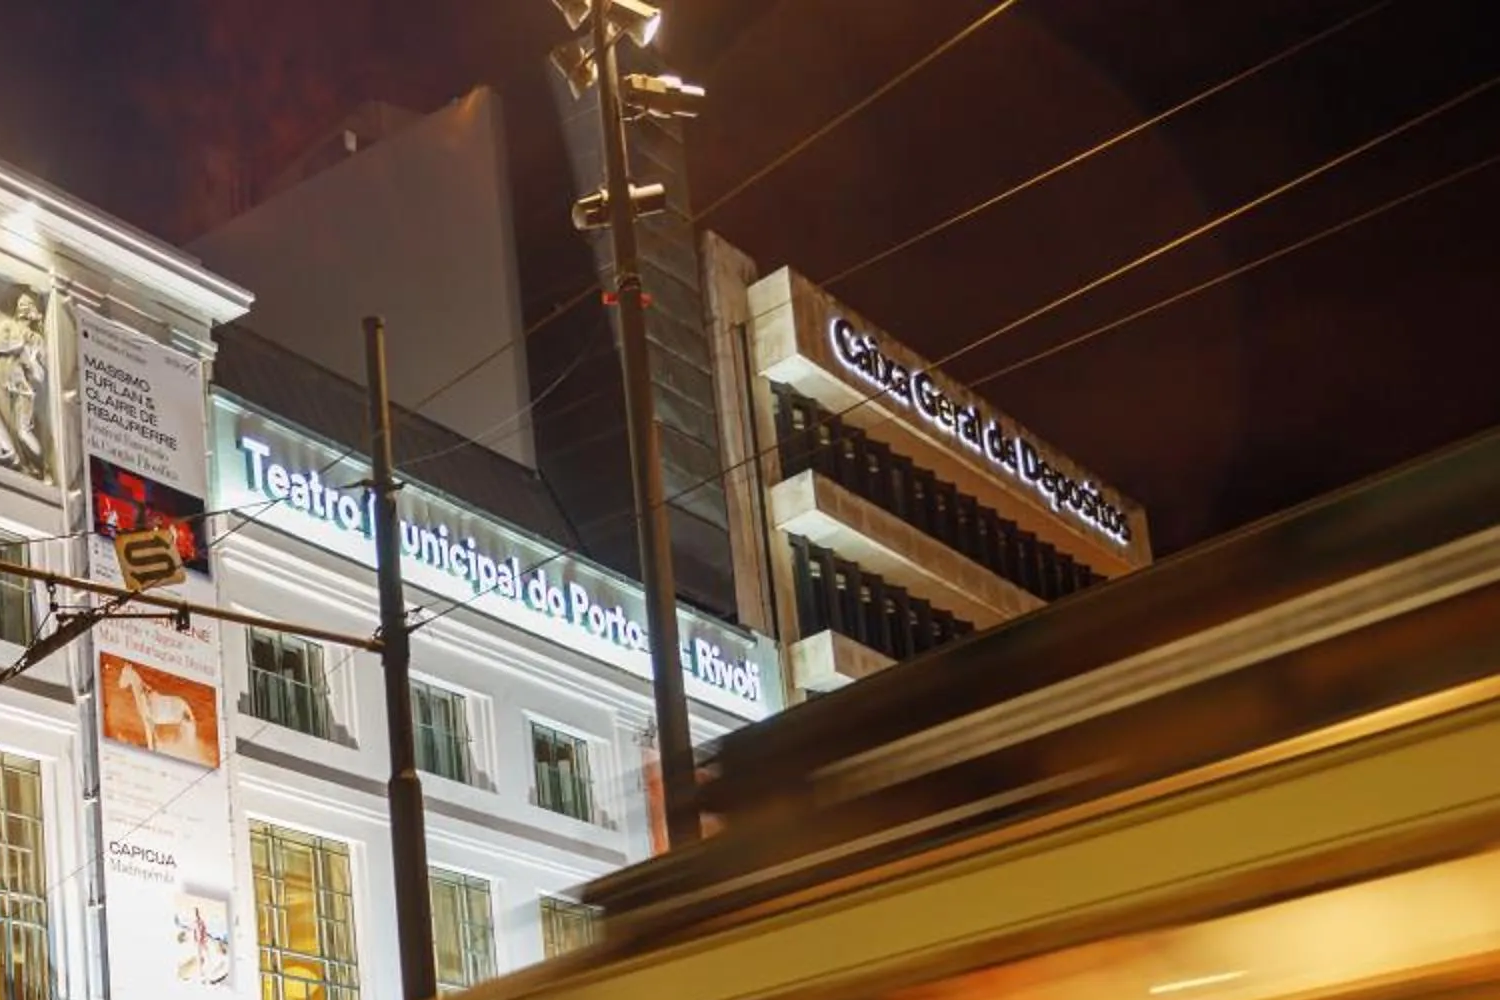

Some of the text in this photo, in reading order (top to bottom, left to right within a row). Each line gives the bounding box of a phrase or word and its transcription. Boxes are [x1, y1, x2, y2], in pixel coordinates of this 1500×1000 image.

[83, 354, 151, 392] MASSIMO
[85, 369, 143, 405] FURLAN
[85, 386, 159, 427] CLAIRE DE
[829, 315, 911, 407] Caixa
[910, 370, 984, 452] Geral
[982, 418, 1018, 474] de
[86, 402, 178, 451] RIBAUPIERRE
[238, 435, 361, 531] Teatro
[527, 568, 566, 618] do
[567, 580, 643, 650] Porto
[694, 637, 762, 701] Rivoli
[108, 840, 178, 869] CAPICUA
